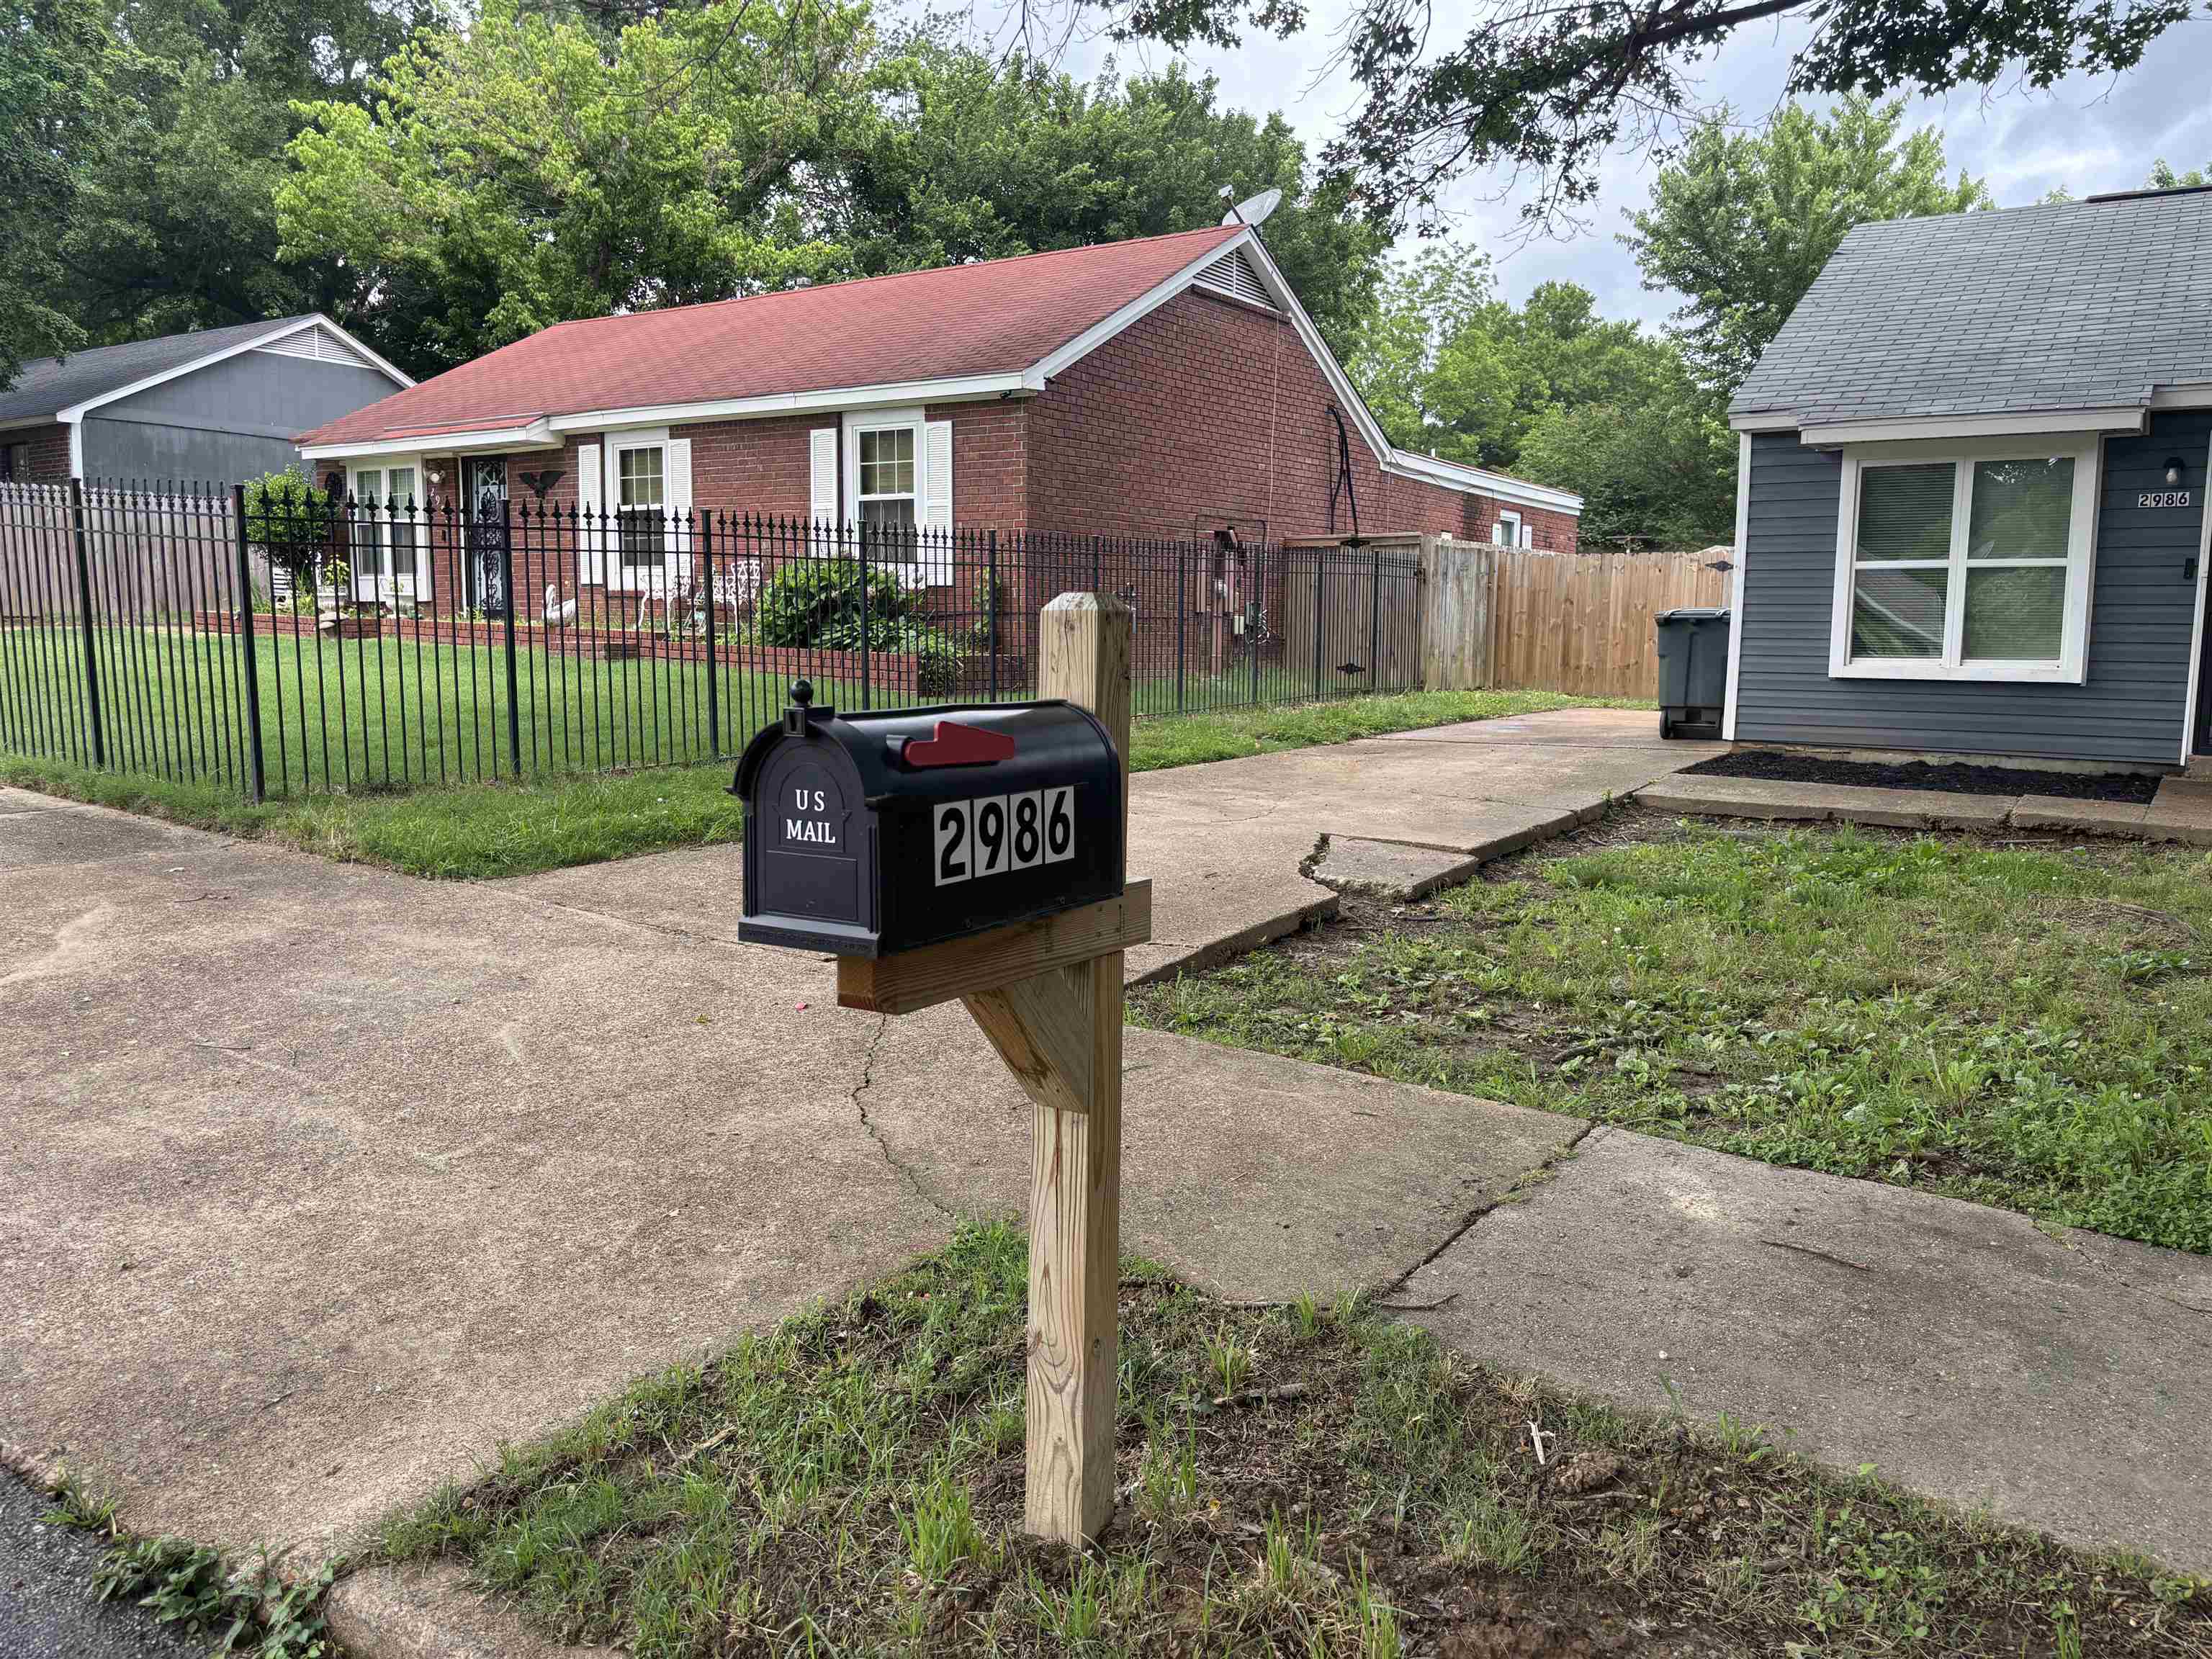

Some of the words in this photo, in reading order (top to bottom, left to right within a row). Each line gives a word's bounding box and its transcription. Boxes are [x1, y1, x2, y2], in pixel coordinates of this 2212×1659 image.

[2139, 493, 2188, 506] 2986
[786, 819, 836, 843] MAIL
[940, 790, 1071, 880] 2986
